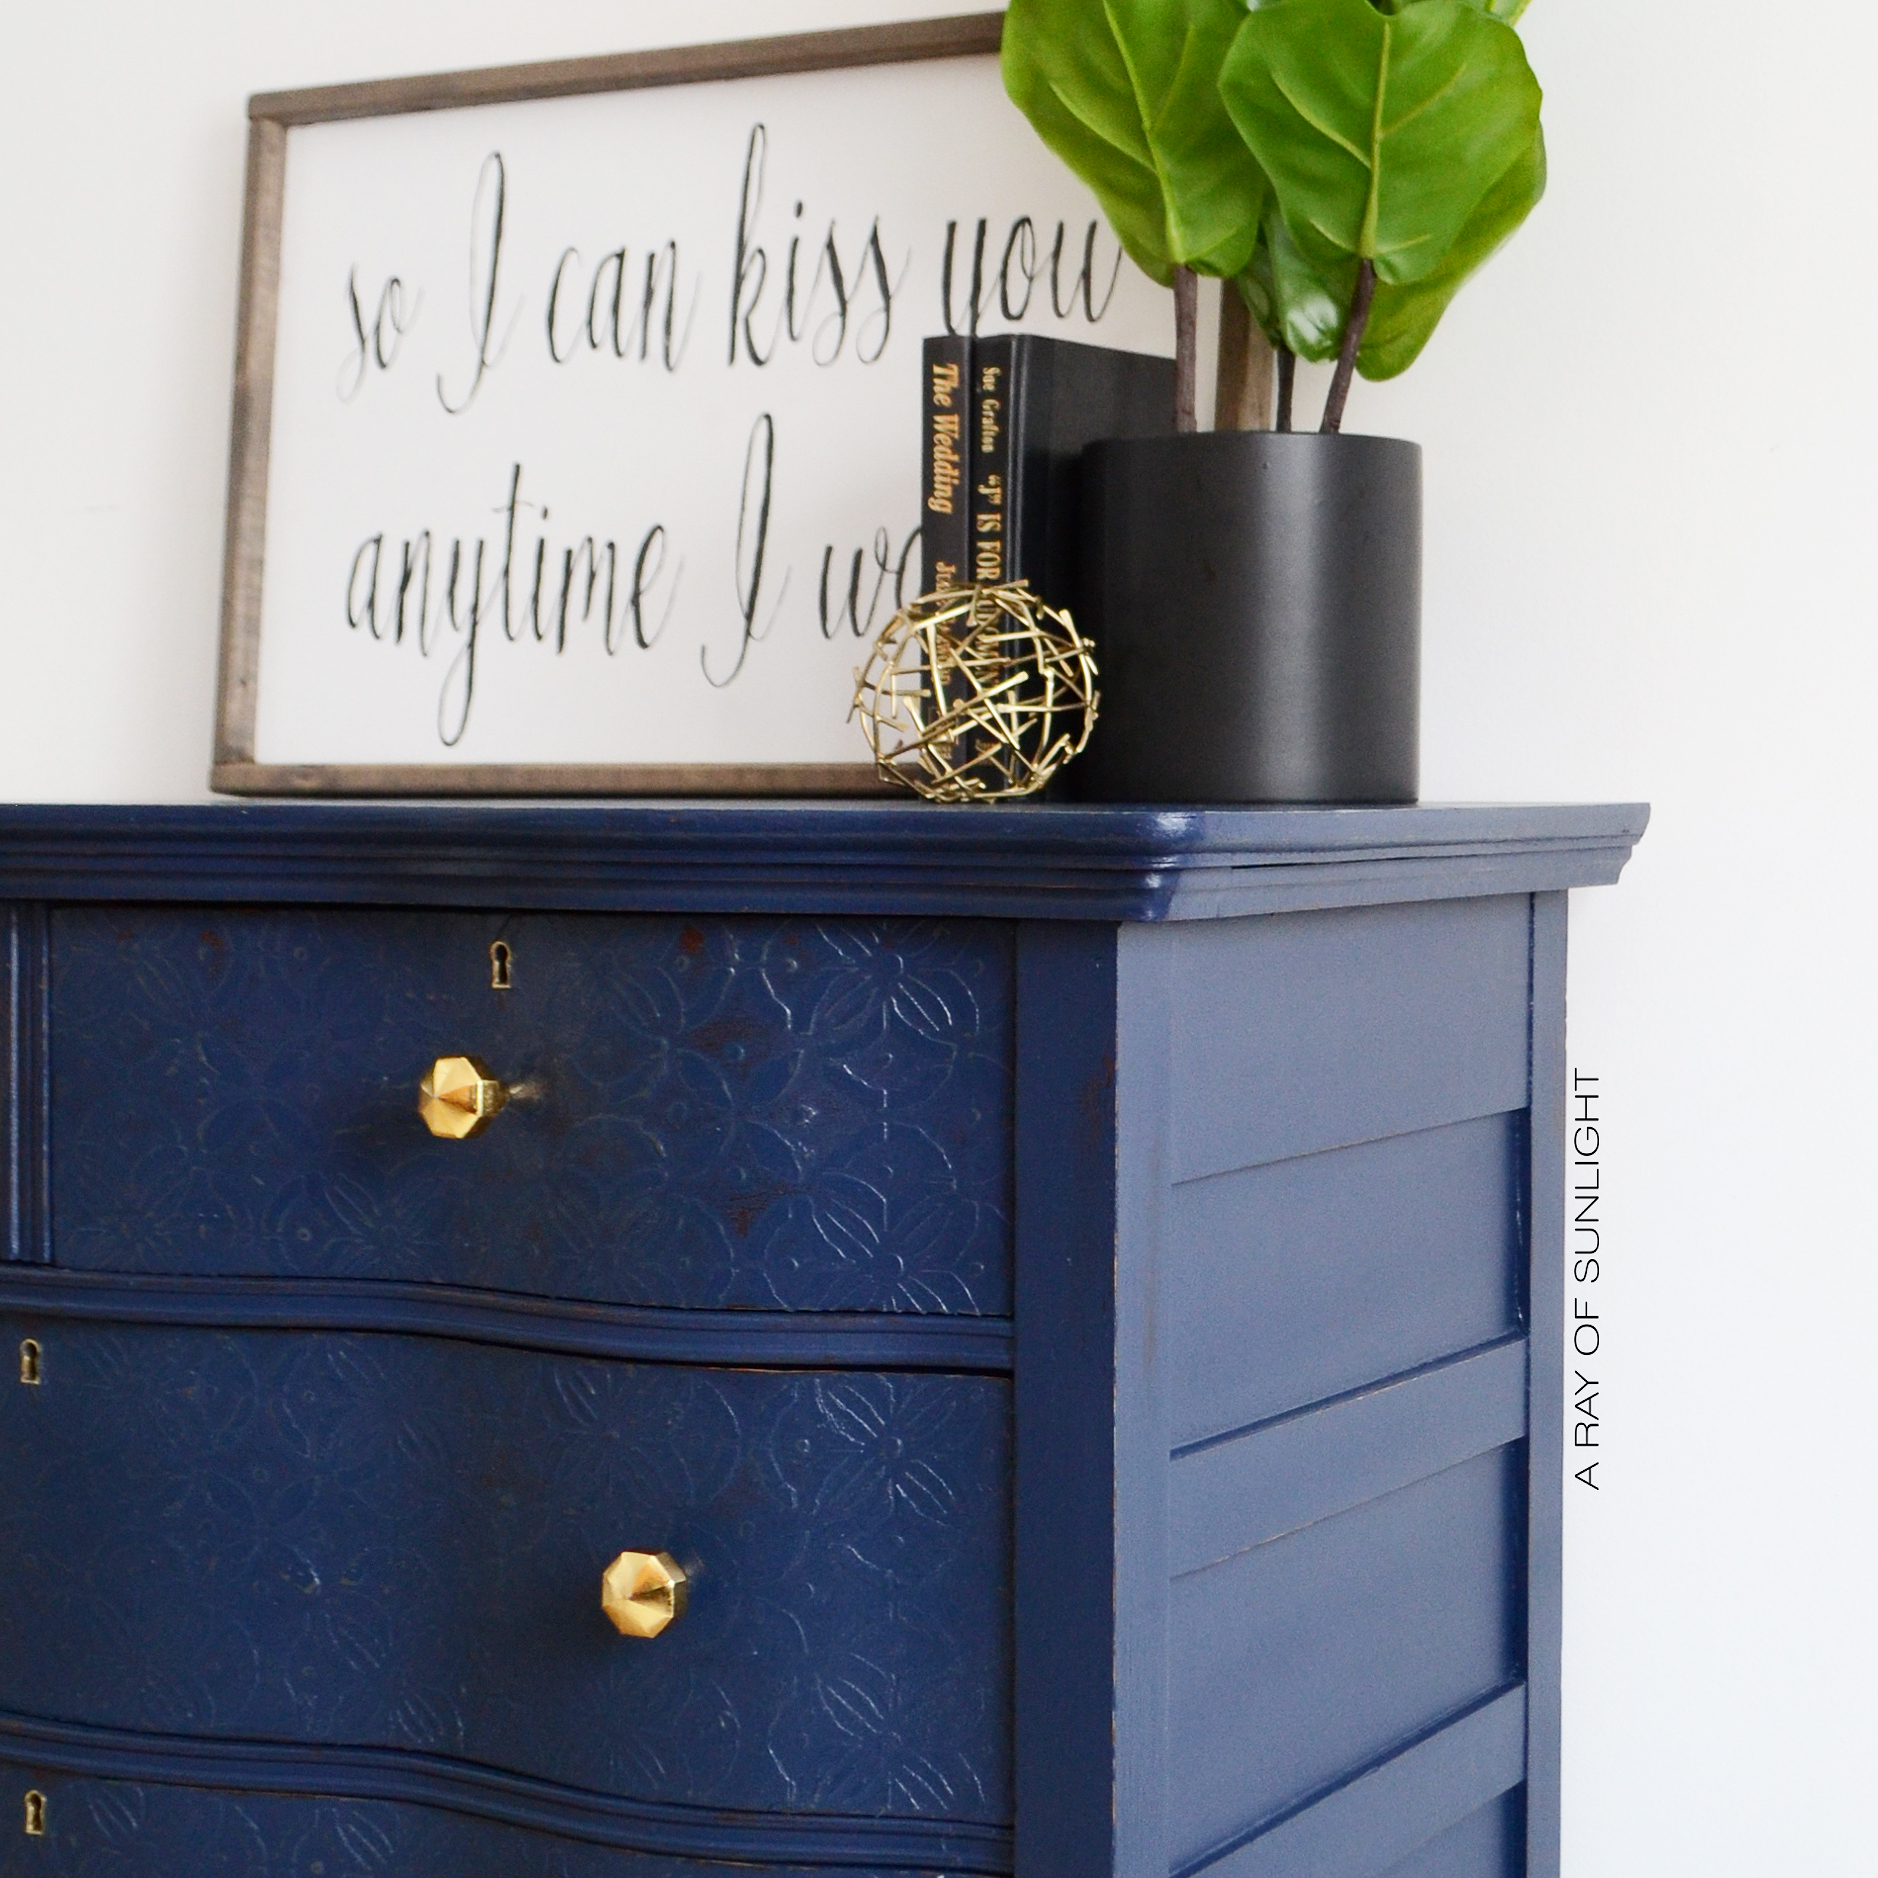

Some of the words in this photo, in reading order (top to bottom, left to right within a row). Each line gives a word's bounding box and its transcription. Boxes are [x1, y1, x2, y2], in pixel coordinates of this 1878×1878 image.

[337, 262, 422, 403] so
[437, 151, 520, 414] I
[547, 239, 699, 372] can
[728, 122, 906, 367] kiss
[941, 215, 1121, 336] you
[932, 362, 960, 408] The
[982, 366, 1001, 392] Sue
[981, 398, 1001, 453] Grafton
[928, 413, 961, 514] Wedding
[976, 512, 1002, 533] IS
[346, 463, 682, 746] anytime
[701, 412, 788, 688] I
[976, 540, 1001, 580] FOR
